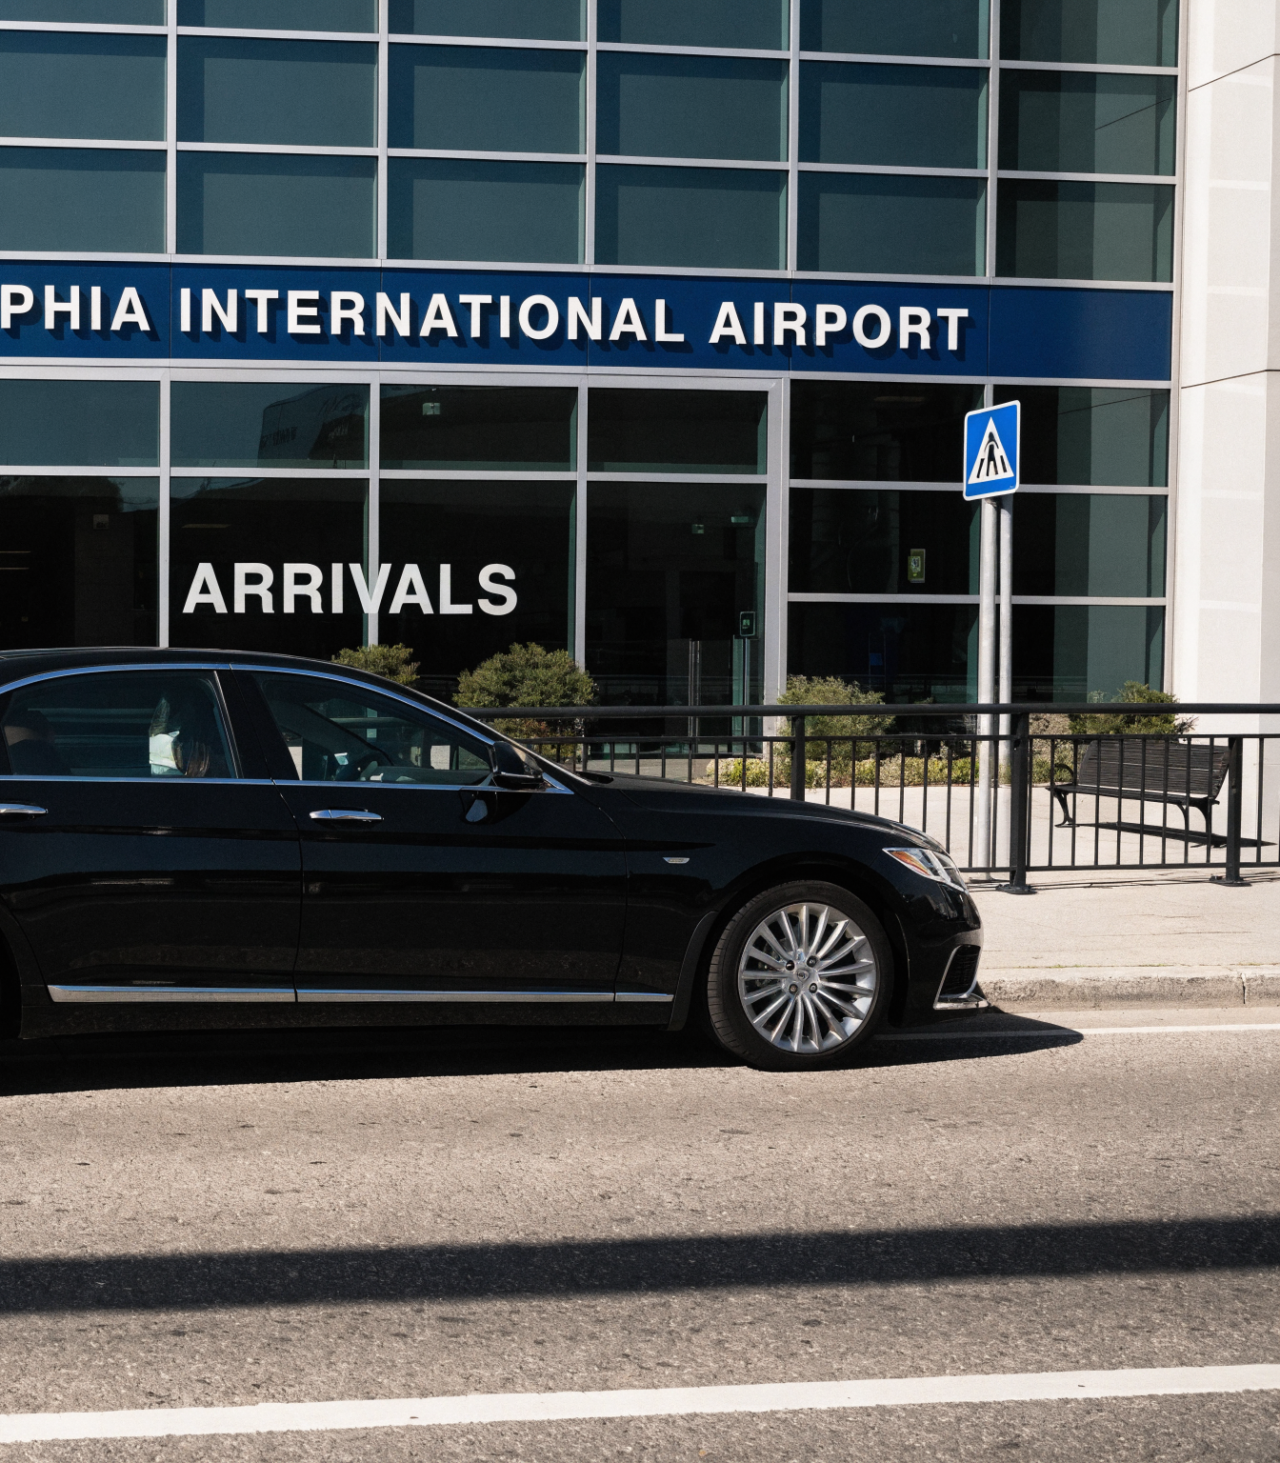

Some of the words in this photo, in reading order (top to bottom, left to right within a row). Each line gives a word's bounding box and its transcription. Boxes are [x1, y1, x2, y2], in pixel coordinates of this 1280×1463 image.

[180, 288, 685, 342] INTERNATIONAL
[709, 301, 969, 351] AIRPORT
[182, 562, 518, 616] ARRIVALS
